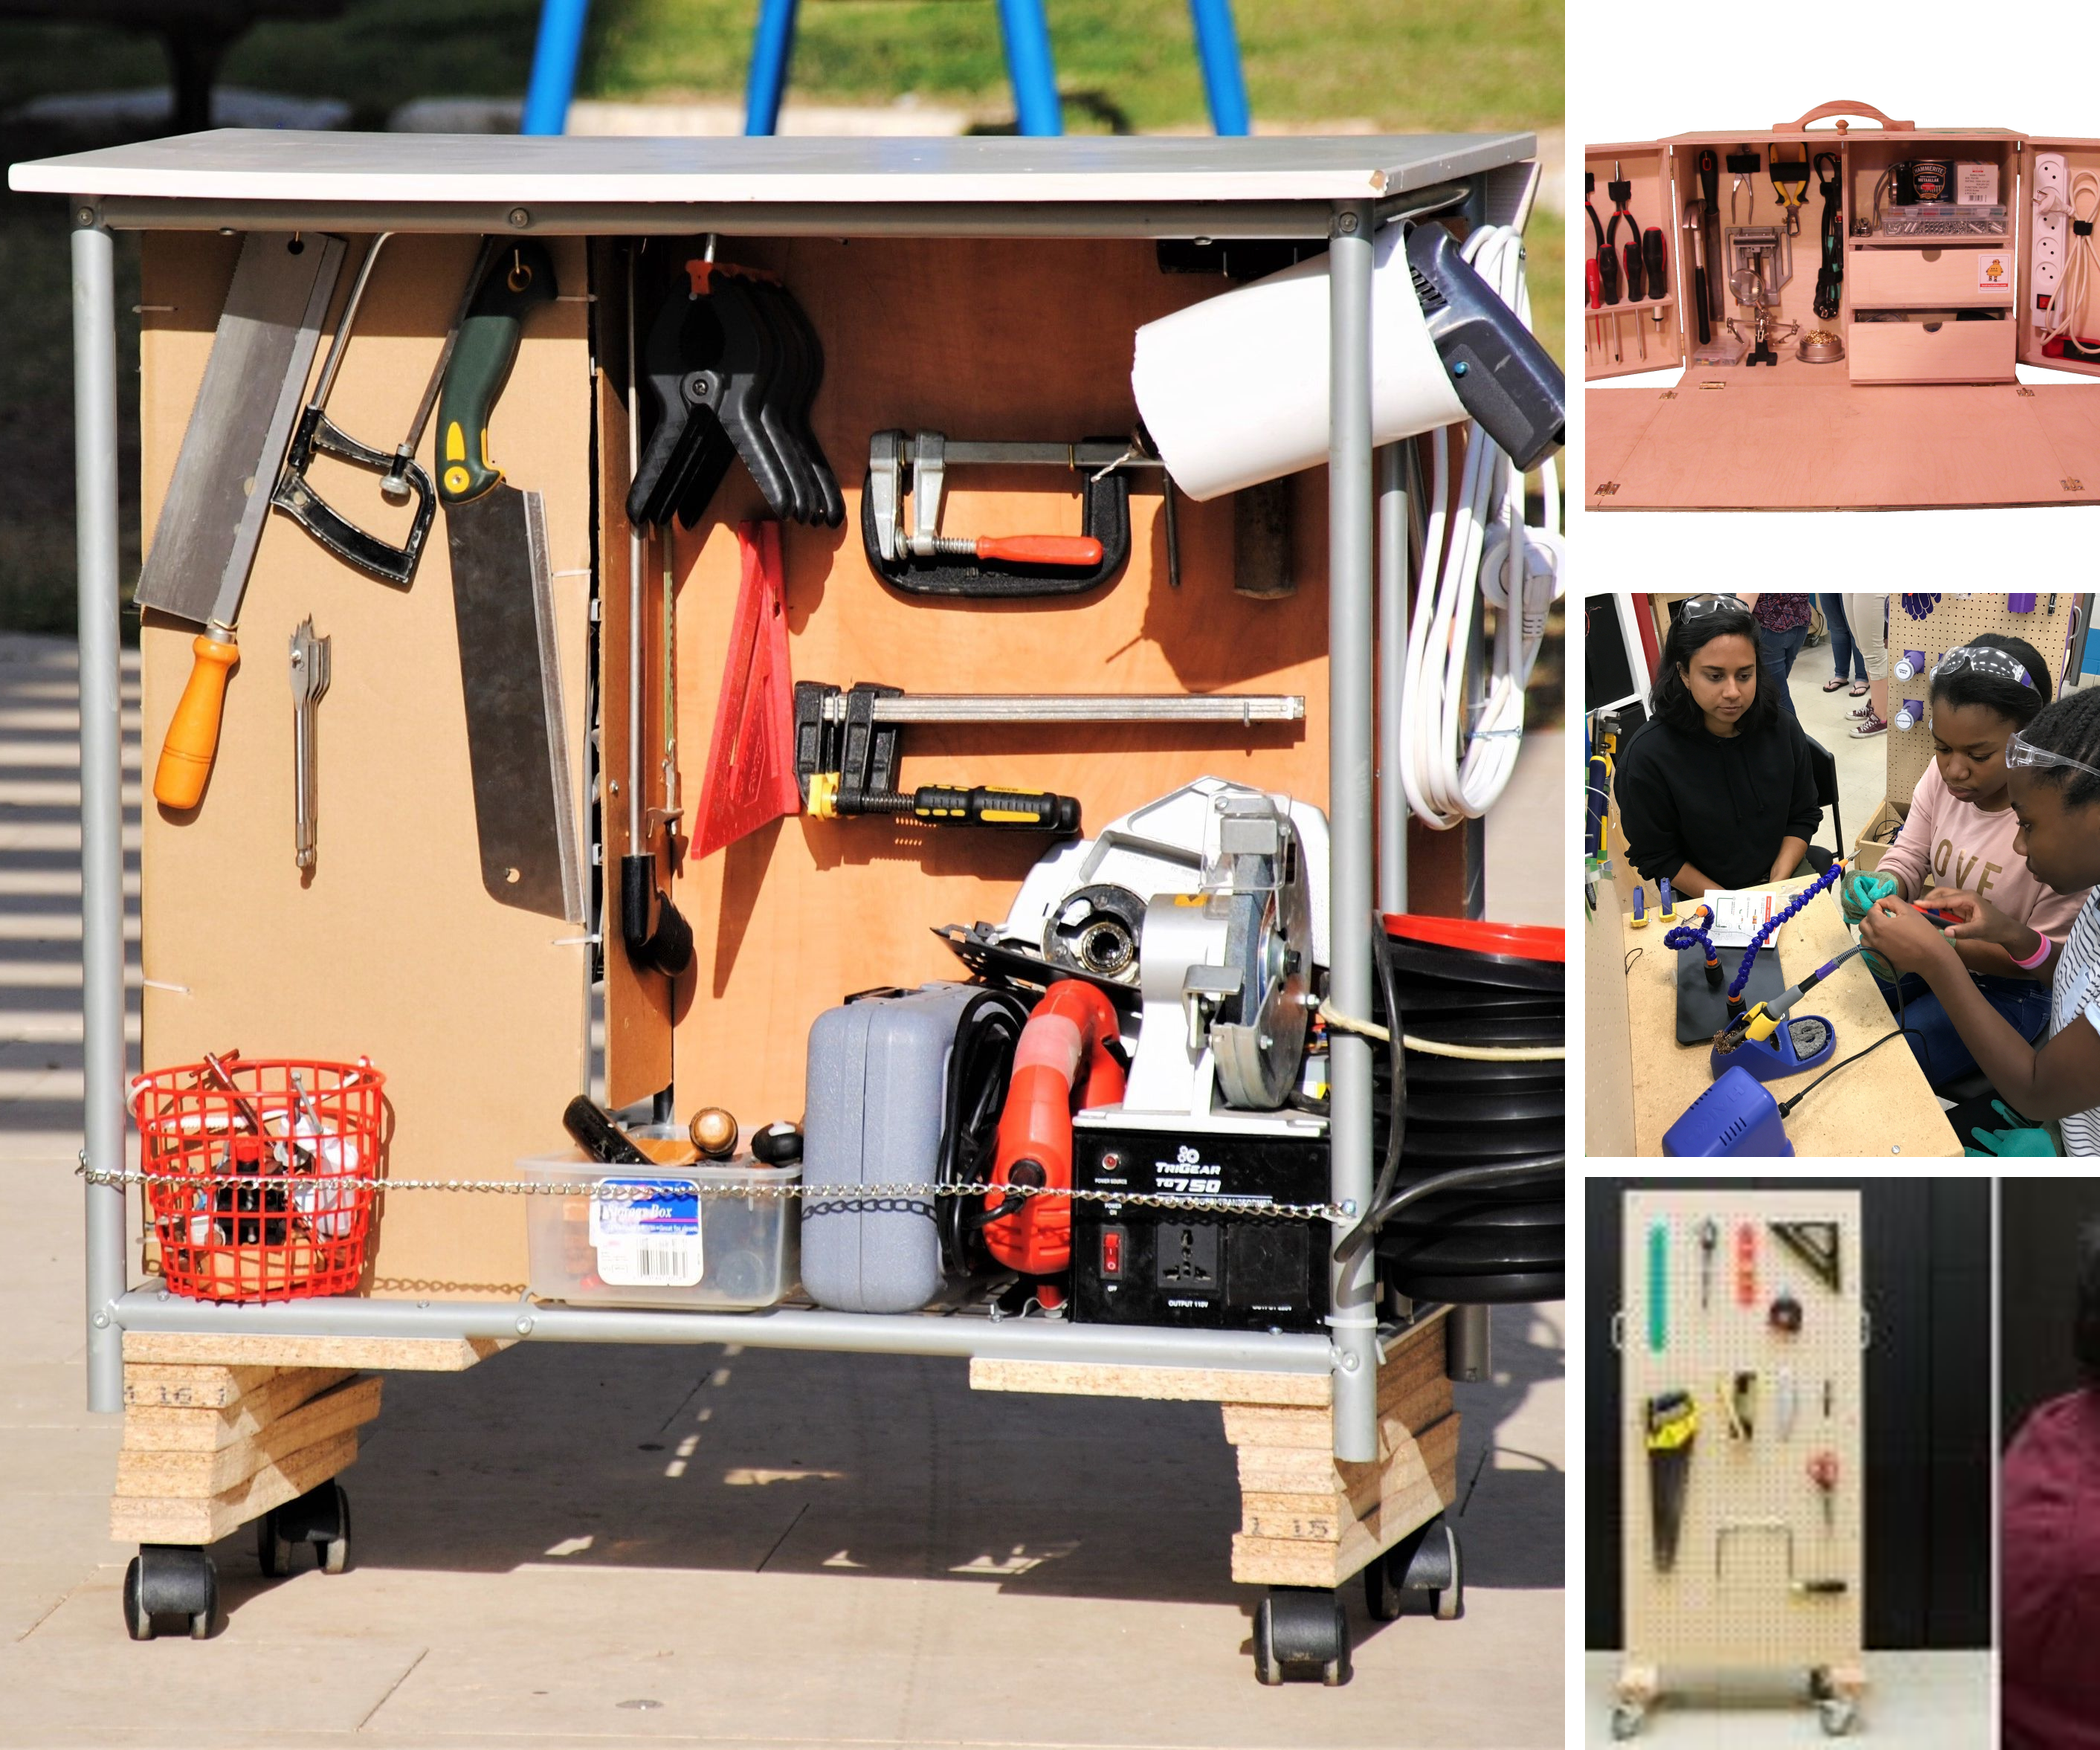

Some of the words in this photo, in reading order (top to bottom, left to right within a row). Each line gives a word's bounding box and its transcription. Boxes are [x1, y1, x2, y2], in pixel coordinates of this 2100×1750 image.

[1914, 165, 1944, 174] HAMMERITE
[1931, 826, 2003, 903] OVE
[651, 1203, 673, 1219] Box
[1168, 1300, 1193, 1308] OUTPUT
